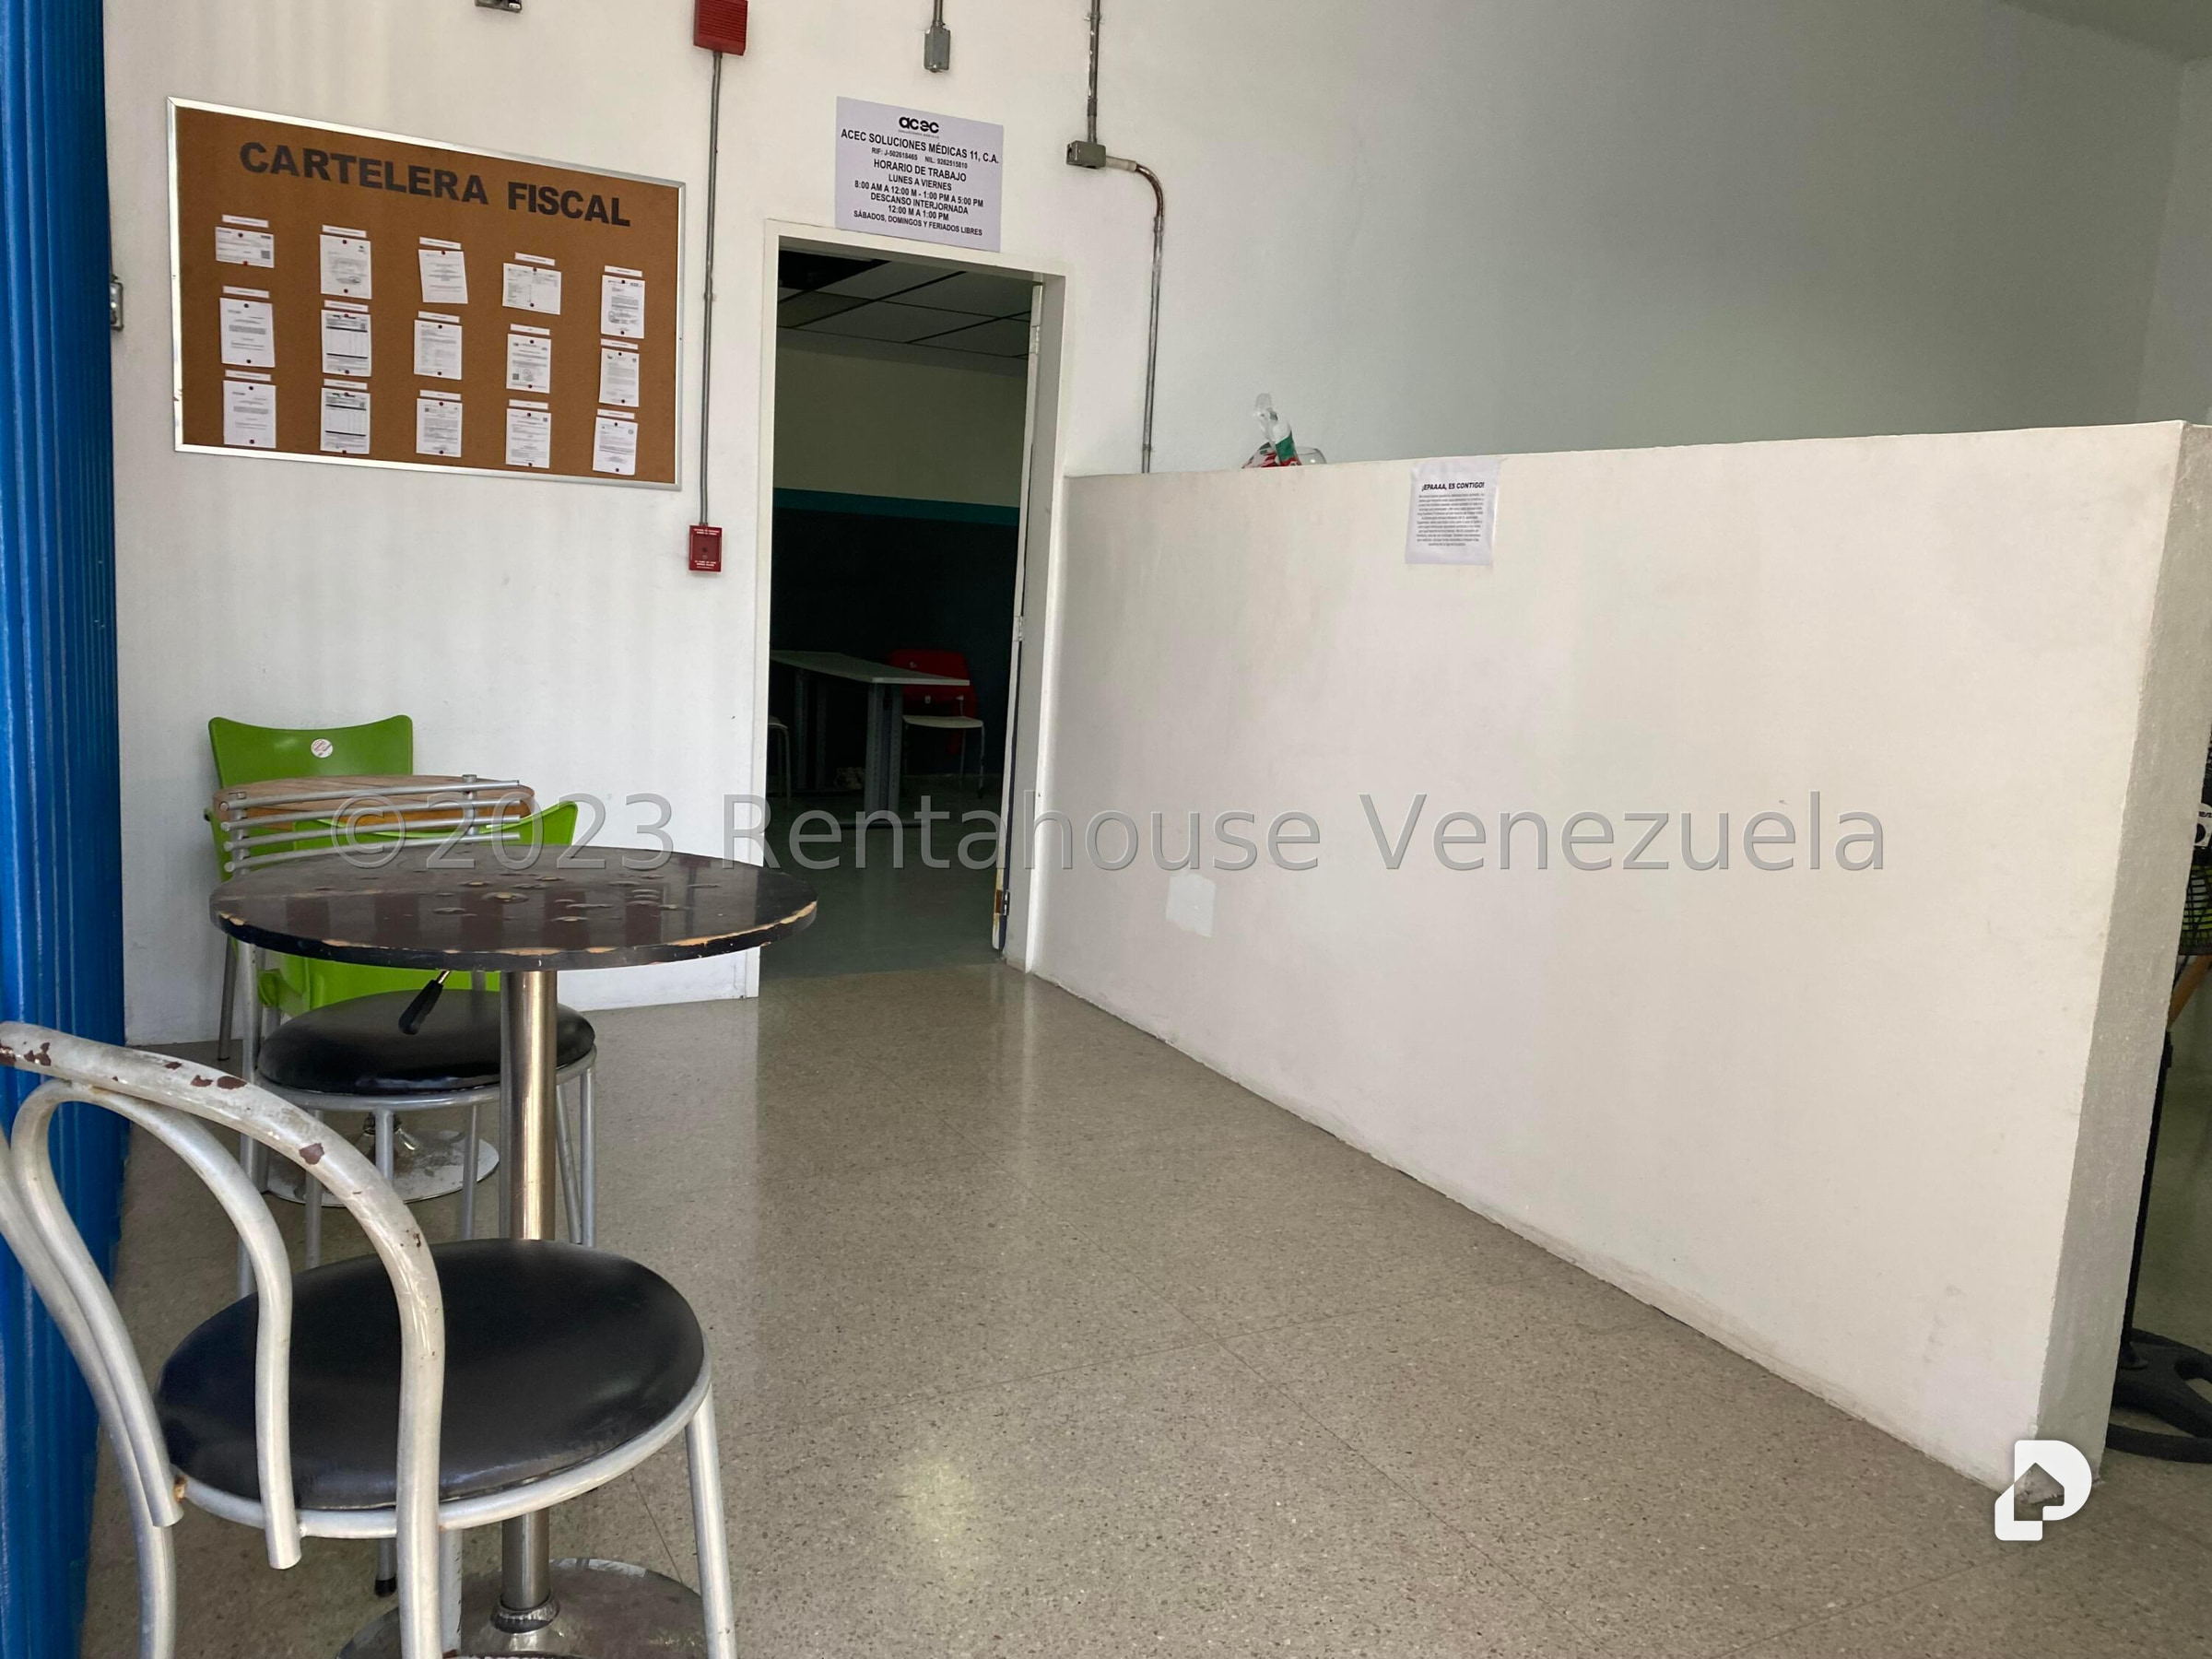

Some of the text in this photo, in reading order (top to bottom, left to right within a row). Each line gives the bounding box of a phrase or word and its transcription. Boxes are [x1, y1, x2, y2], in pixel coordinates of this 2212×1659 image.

[899, 116, 939, 134] acec
[841, 128, 866, 141] ACEC
[868, 133, 926, 151] SOLUCIONES
[929, 142, 968, 159] MÉDICAS
[970, 150, 981, 162] 11,
[982, 152, 999, 164] C.A.
[874, 159, 967, 182] HORARIO DE TRABAJO
[888, 173, 952, 191] LUNES A VIERNES
[239, 141, 630, 227] CARTELERA FISCAL
[854, 180, 870, 190] 8:00
[870, 182, 883, 192] AM
[883, 184, 889, 193] A
[891, 186, 910, 195] 12:00
[911, 188, 917, 197] M
[924, 191, 937, 200] 1:00
[938, 193, 949, 202] PM
[950, 194, 957, 203] A
[958, 195, 971, 206] 5:00
[972, 198, 983, 207] PM
[870, 192, 969, 215] DESCANSO INTERJORNADA
[888, 205, 949, 221] 12:00 M A 1:00 PM
[853, 209, 887, 222] SÁBADOS,
[888, 215, 922, 227] DOMINGOS
[928, 221, 960, 232] FERIADOS
[960, 226, 982, 236] LIBRES
[1456, 481, 1485, 489] CONTIGO!
